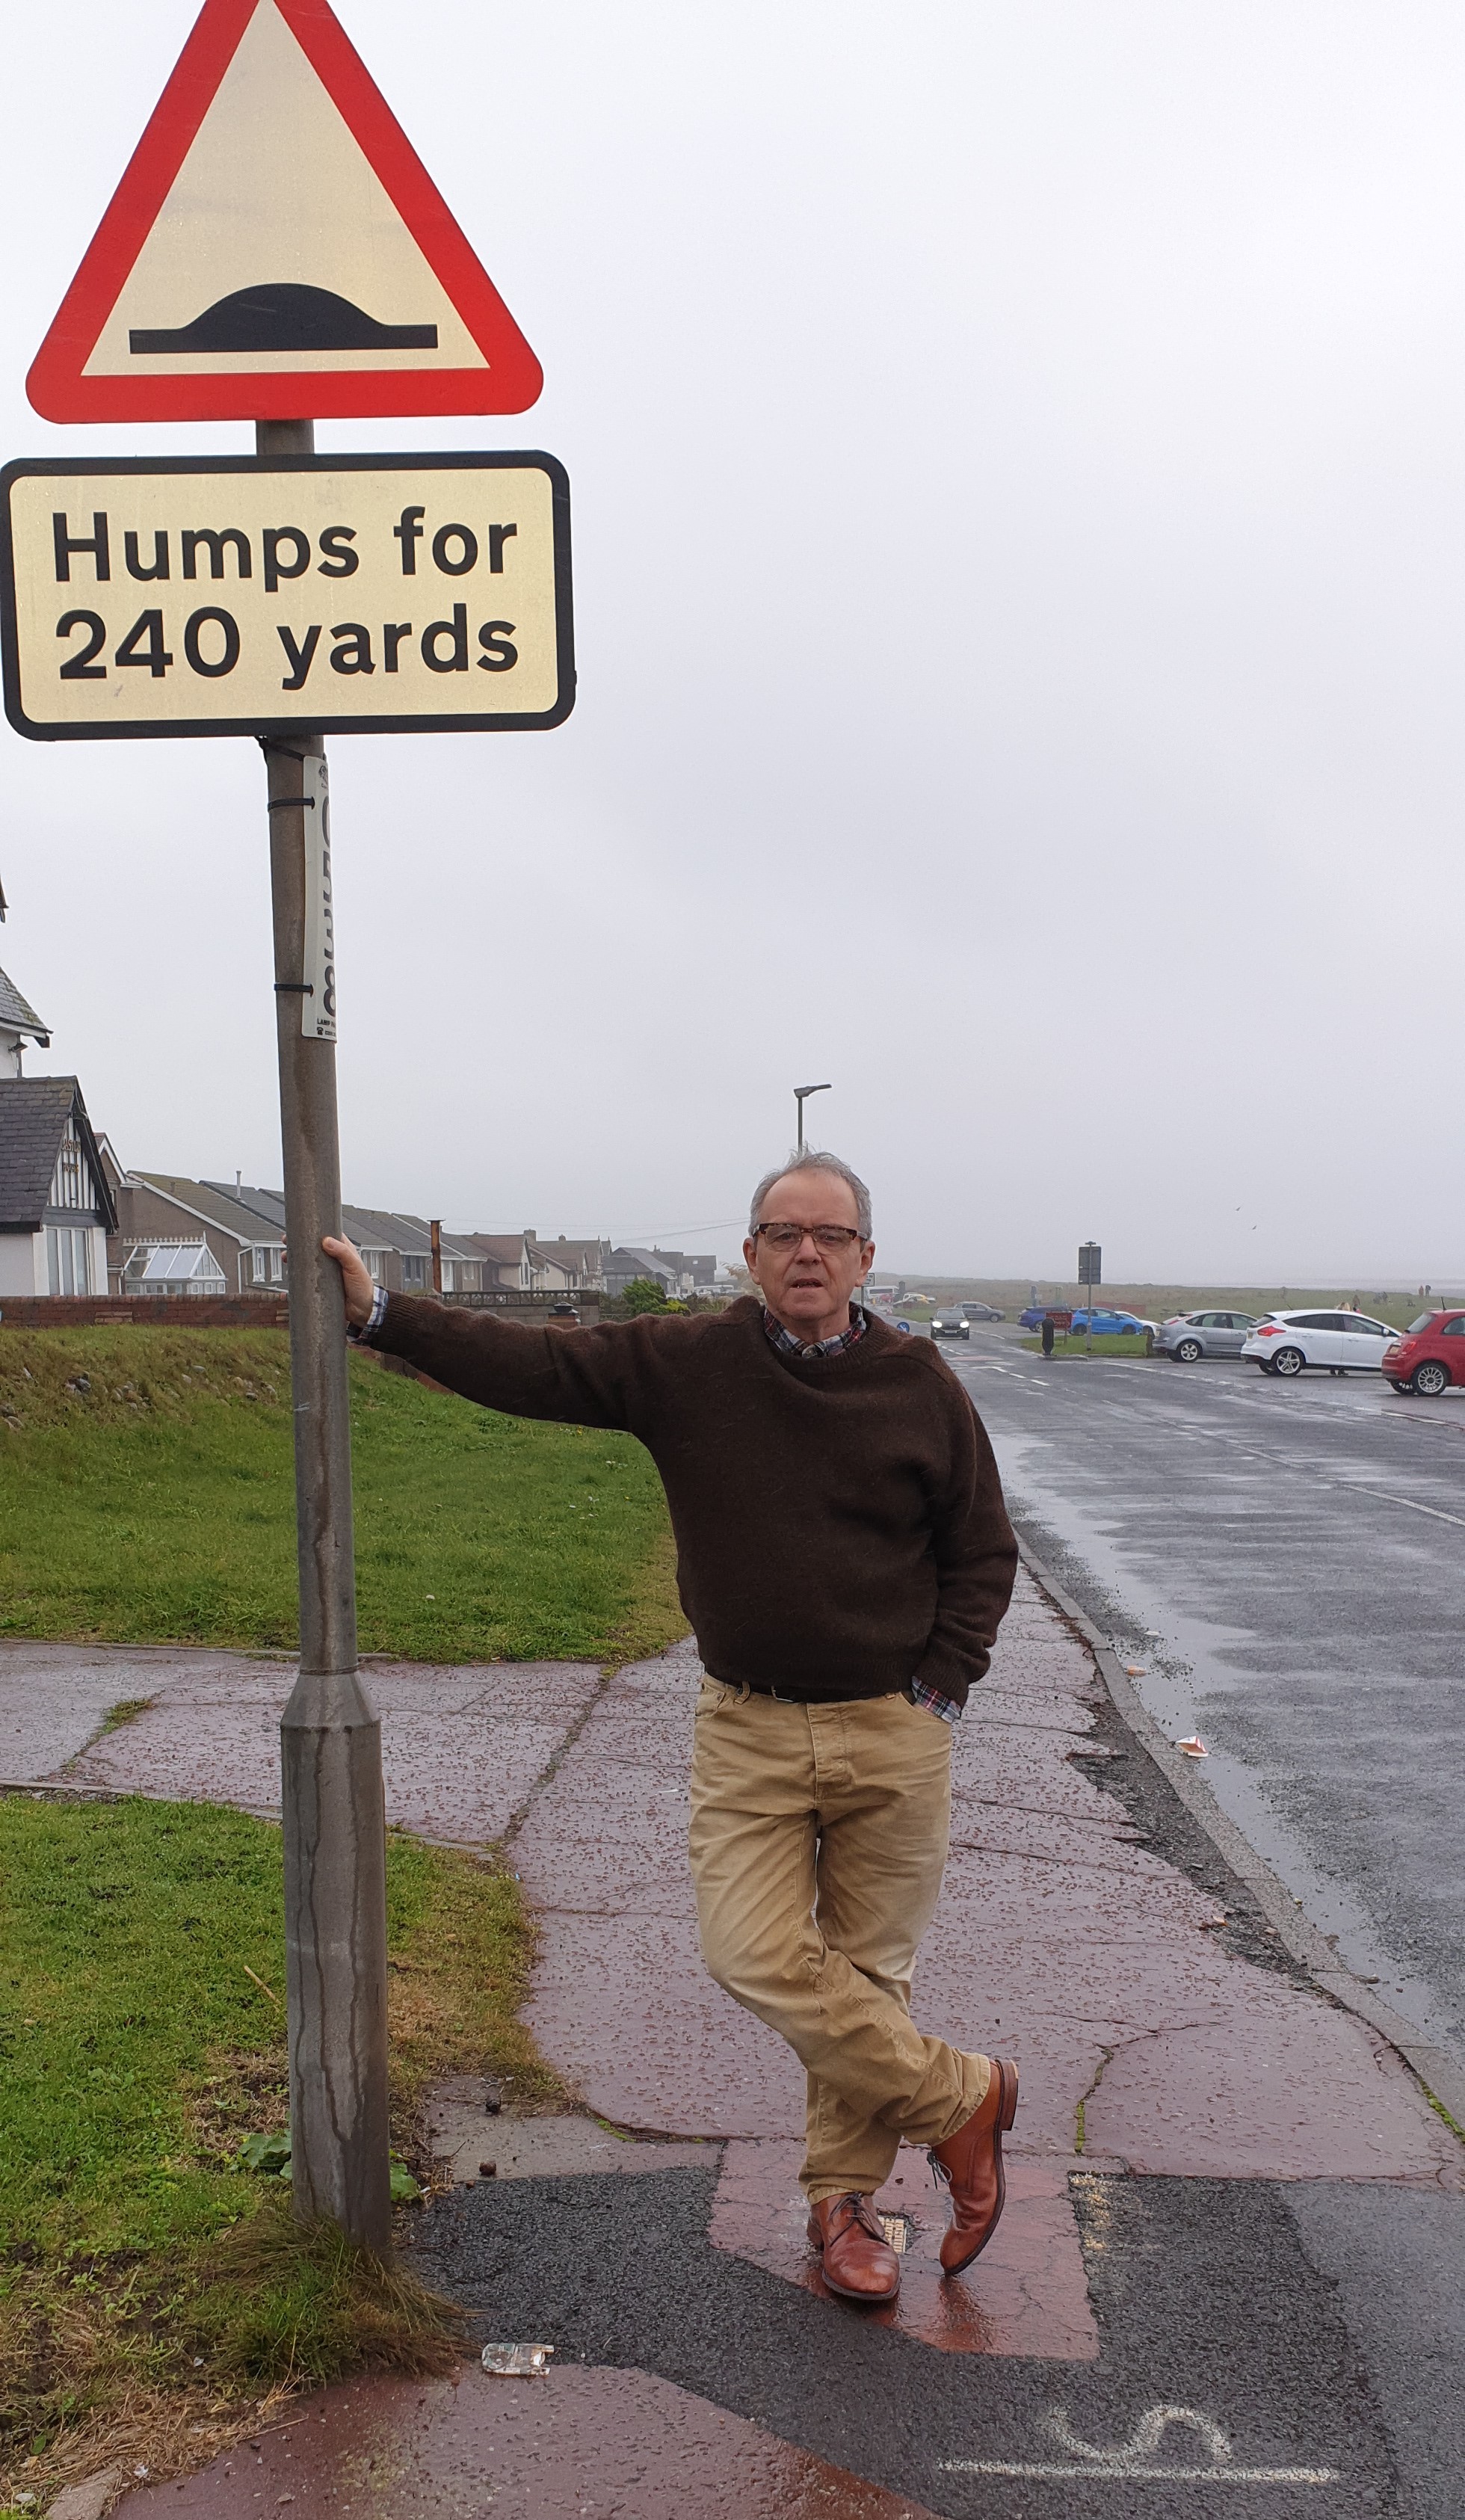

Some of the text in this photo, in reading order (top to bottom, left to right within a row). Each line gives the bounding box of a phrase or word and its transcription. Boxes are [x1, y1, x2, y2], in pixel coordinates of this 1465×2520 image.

[52, 505, 518, 593] Humps for
[55, 603, 519, 690] 240 yards
